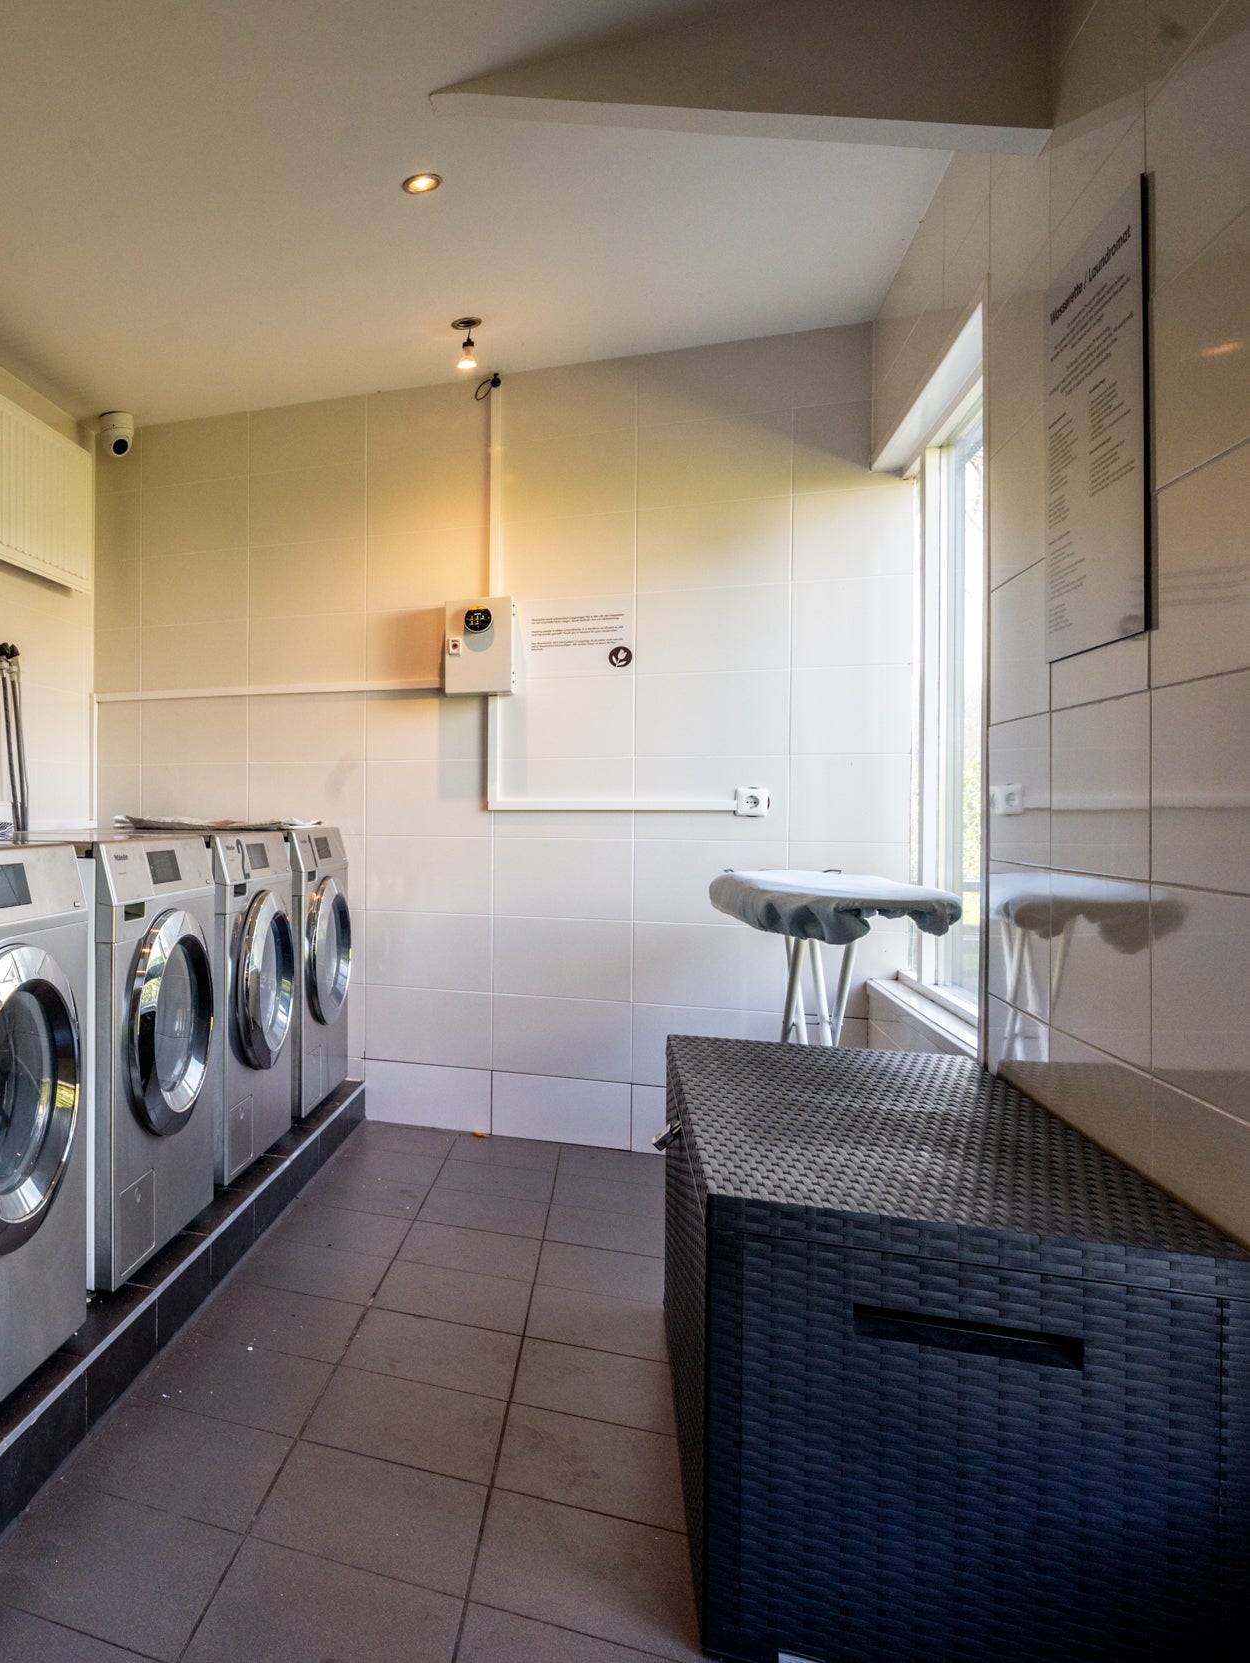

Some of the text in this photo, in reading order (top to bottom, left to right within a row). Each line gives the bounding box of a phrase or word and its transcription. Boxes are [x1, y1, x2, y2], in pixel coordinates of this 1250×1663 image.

[1050, 282, 1082, 325] Wasserette
[1088, 224, 1131, 283] Laundromat
[236, 839, 250, 879] 2
